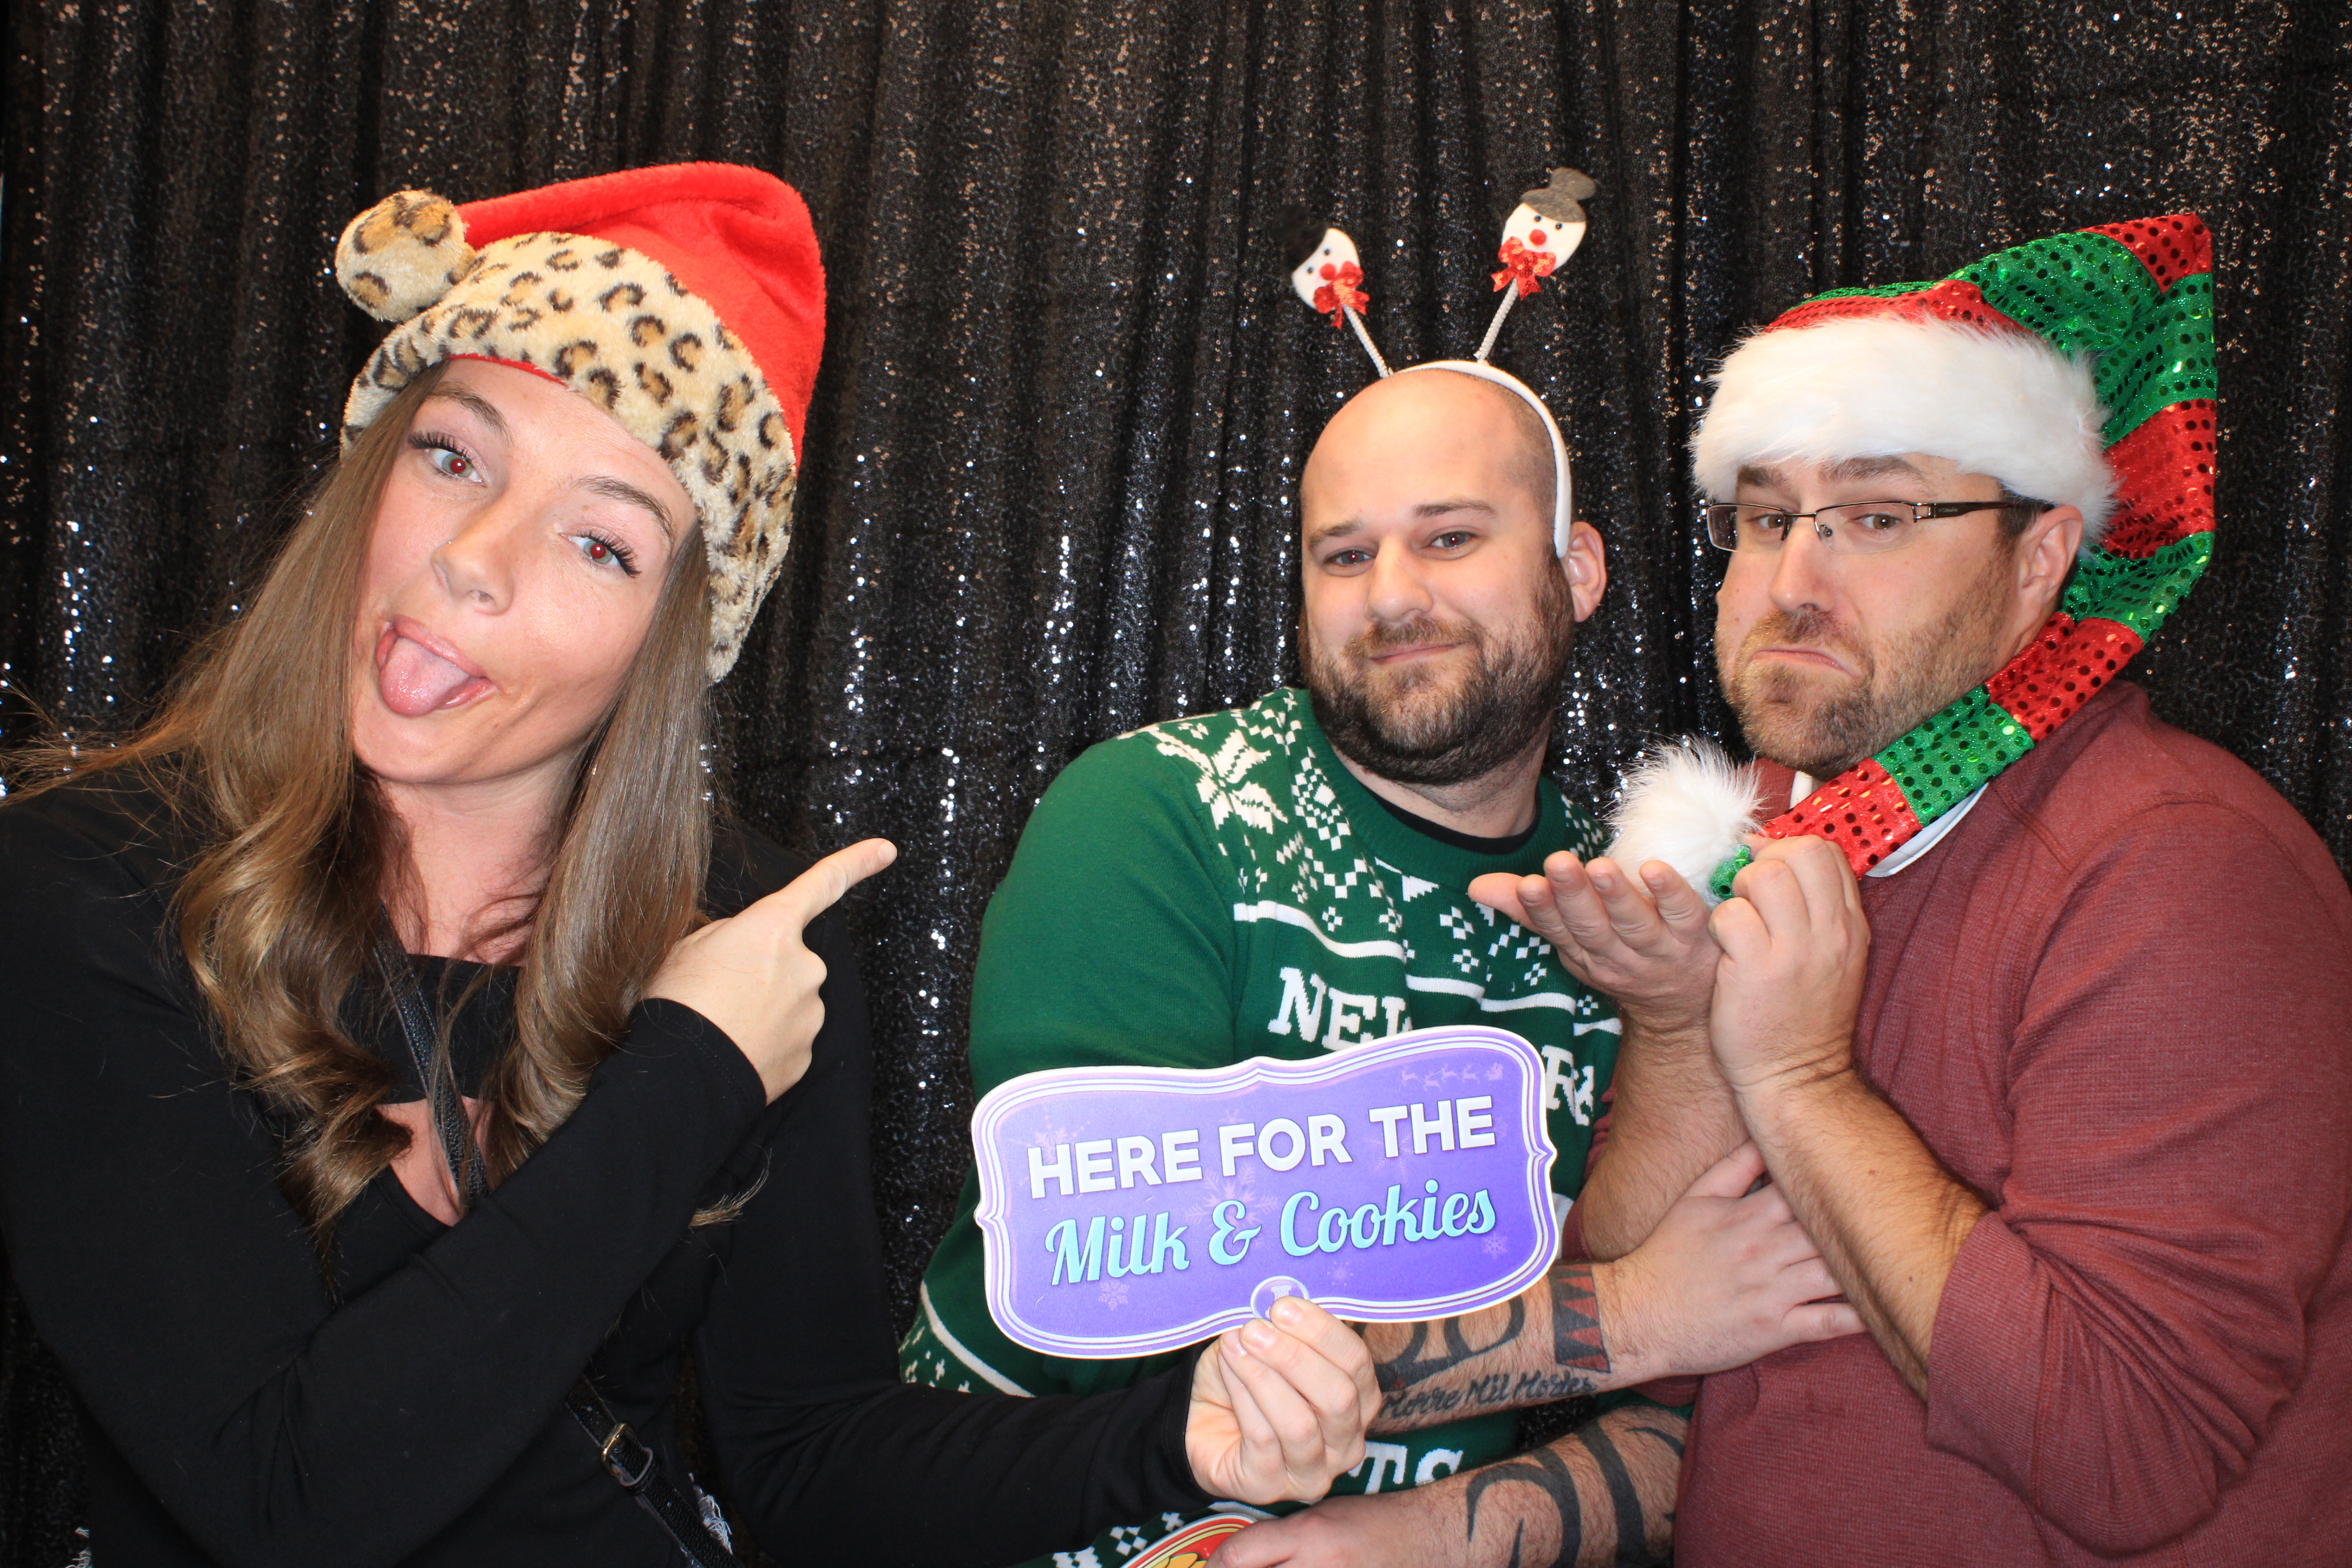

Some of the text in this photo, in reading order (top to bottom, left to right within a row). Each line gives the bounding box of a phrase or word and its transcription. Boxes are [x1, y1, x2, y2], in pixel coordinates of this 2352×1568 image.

[1541, 1044, 1595, 1126] RK
[1027, 1095, 1496, 1199] HERE FOR THE
[1044, 1179, 1496, 1286] Milk & Cookies
